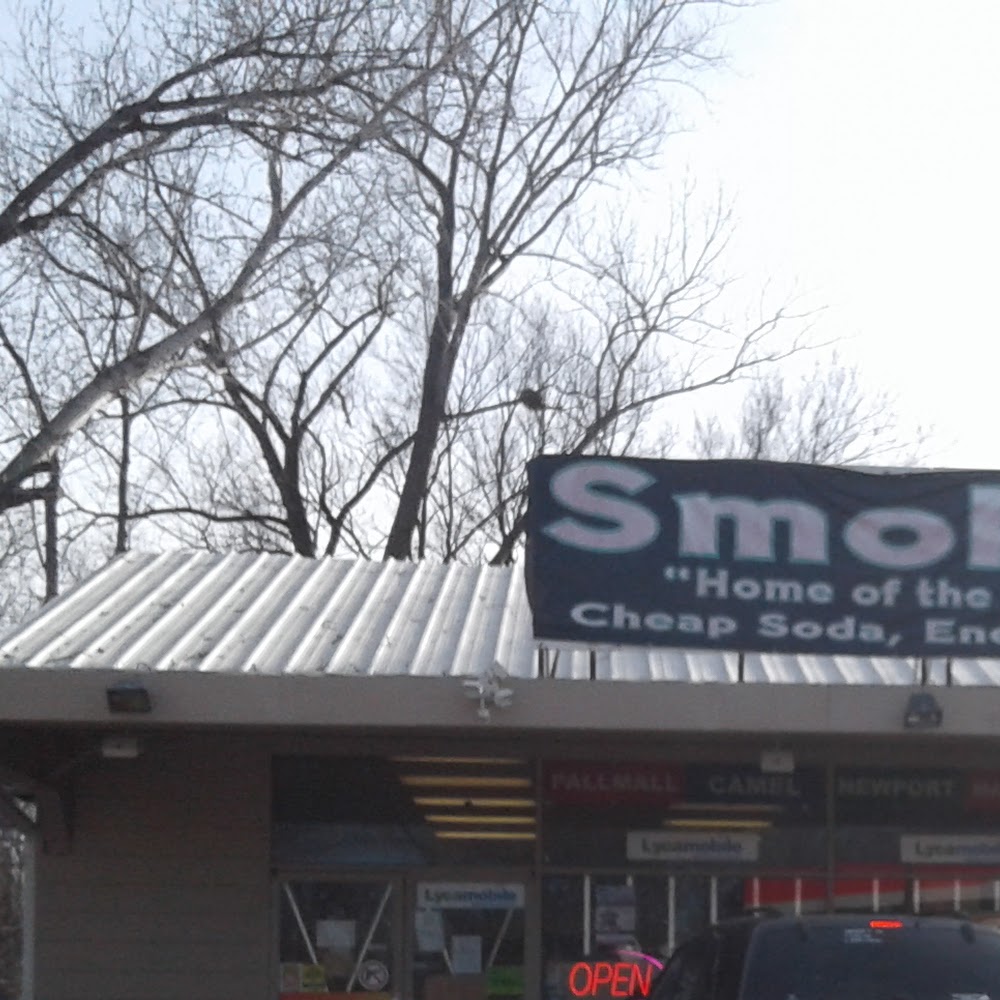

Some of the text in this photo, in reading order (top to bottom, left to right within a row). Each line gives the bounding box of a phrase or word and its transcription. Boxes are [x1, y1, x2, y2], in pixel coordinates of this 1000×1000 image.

[663, 565, 834, 604] "Home
[852, 578, 901, 607] of
[916, 577, 991, 608] the
[570, 602, 738, 639] Cheap
[757, 614, 903, 647] Soda,
[707, 773, 801, 796] CAMEL
[838, 779, 953, 797] NEWPORT
[568, 961, 653, 998] OPEN
